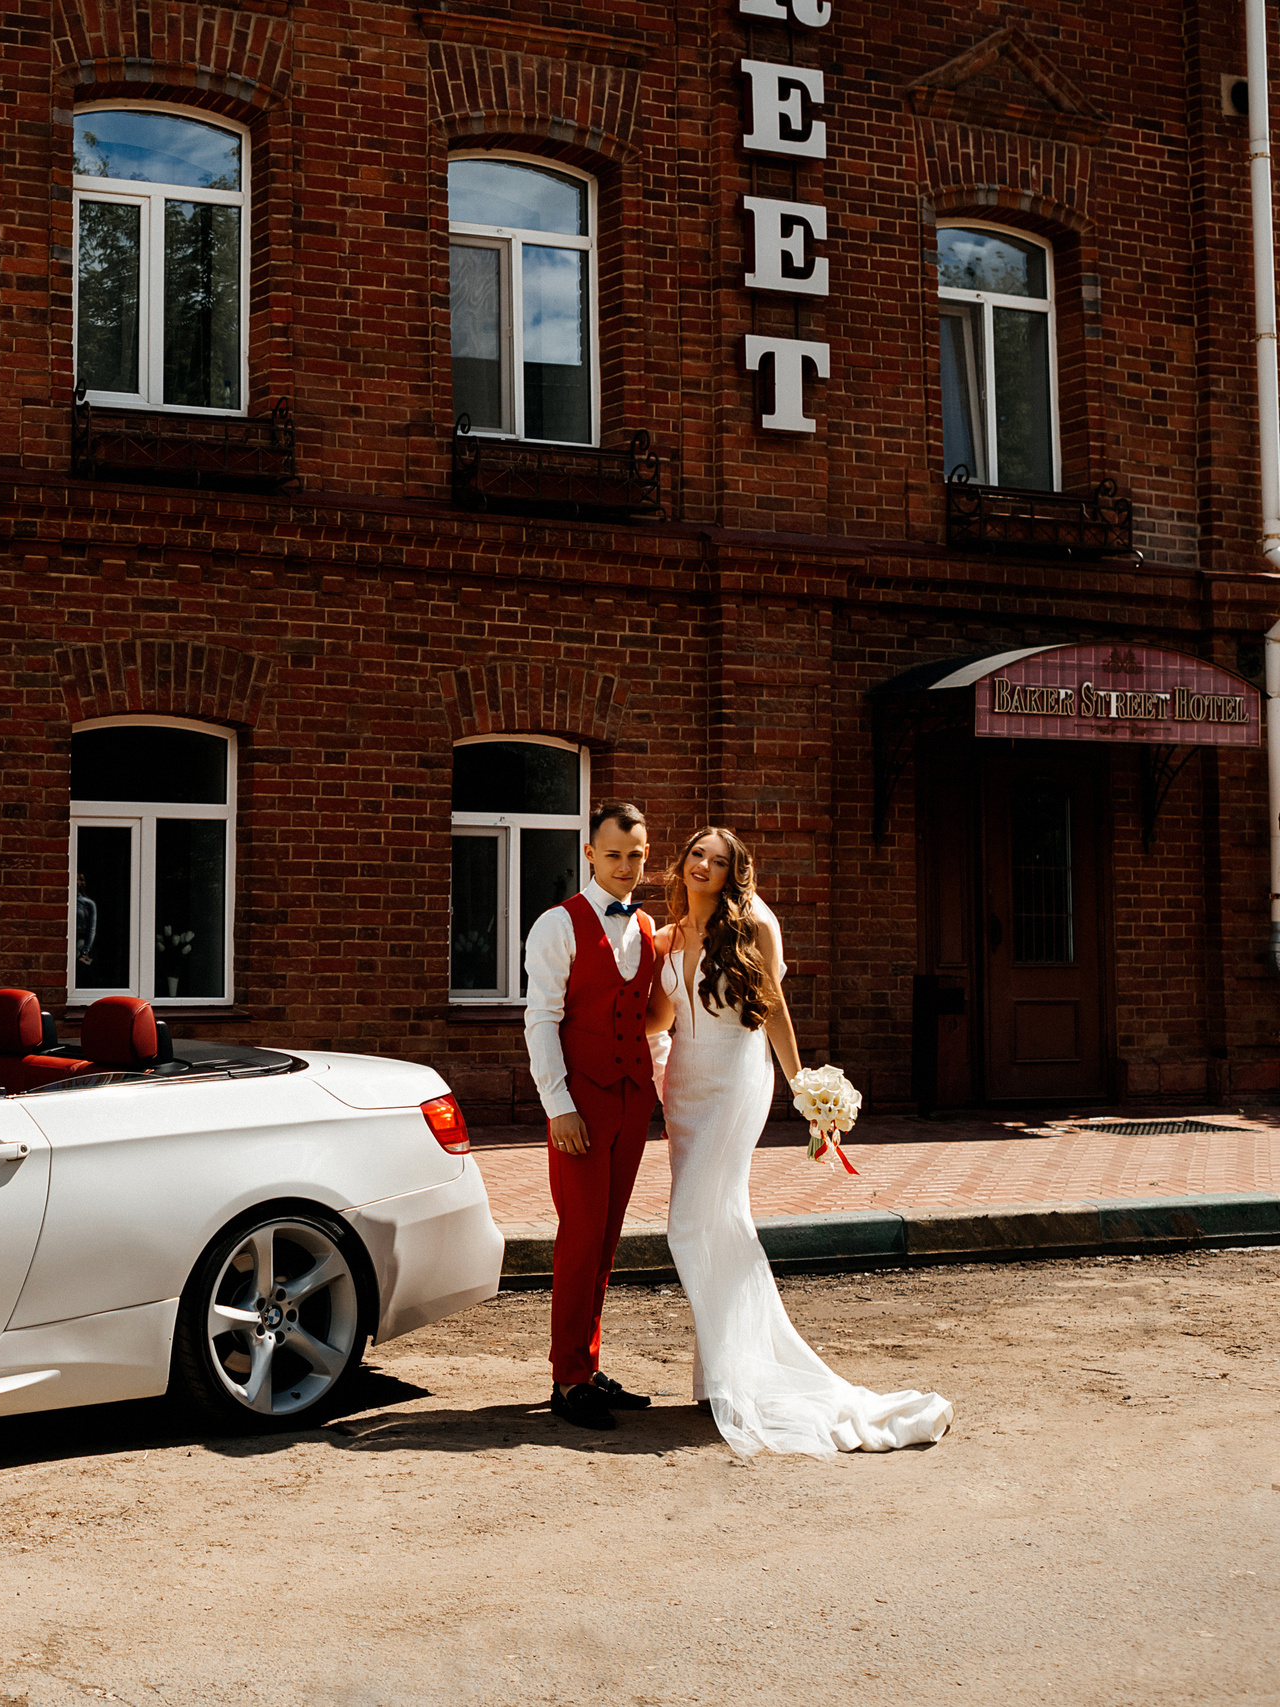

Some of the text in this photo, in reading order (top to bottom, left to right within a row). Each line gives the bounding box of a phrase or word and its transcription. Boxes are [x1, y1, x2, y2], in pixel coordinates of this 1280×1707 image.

[739, 0, 831, 433] EET
[994, 677, 1250, 724] BAKER STREET HOTEL
